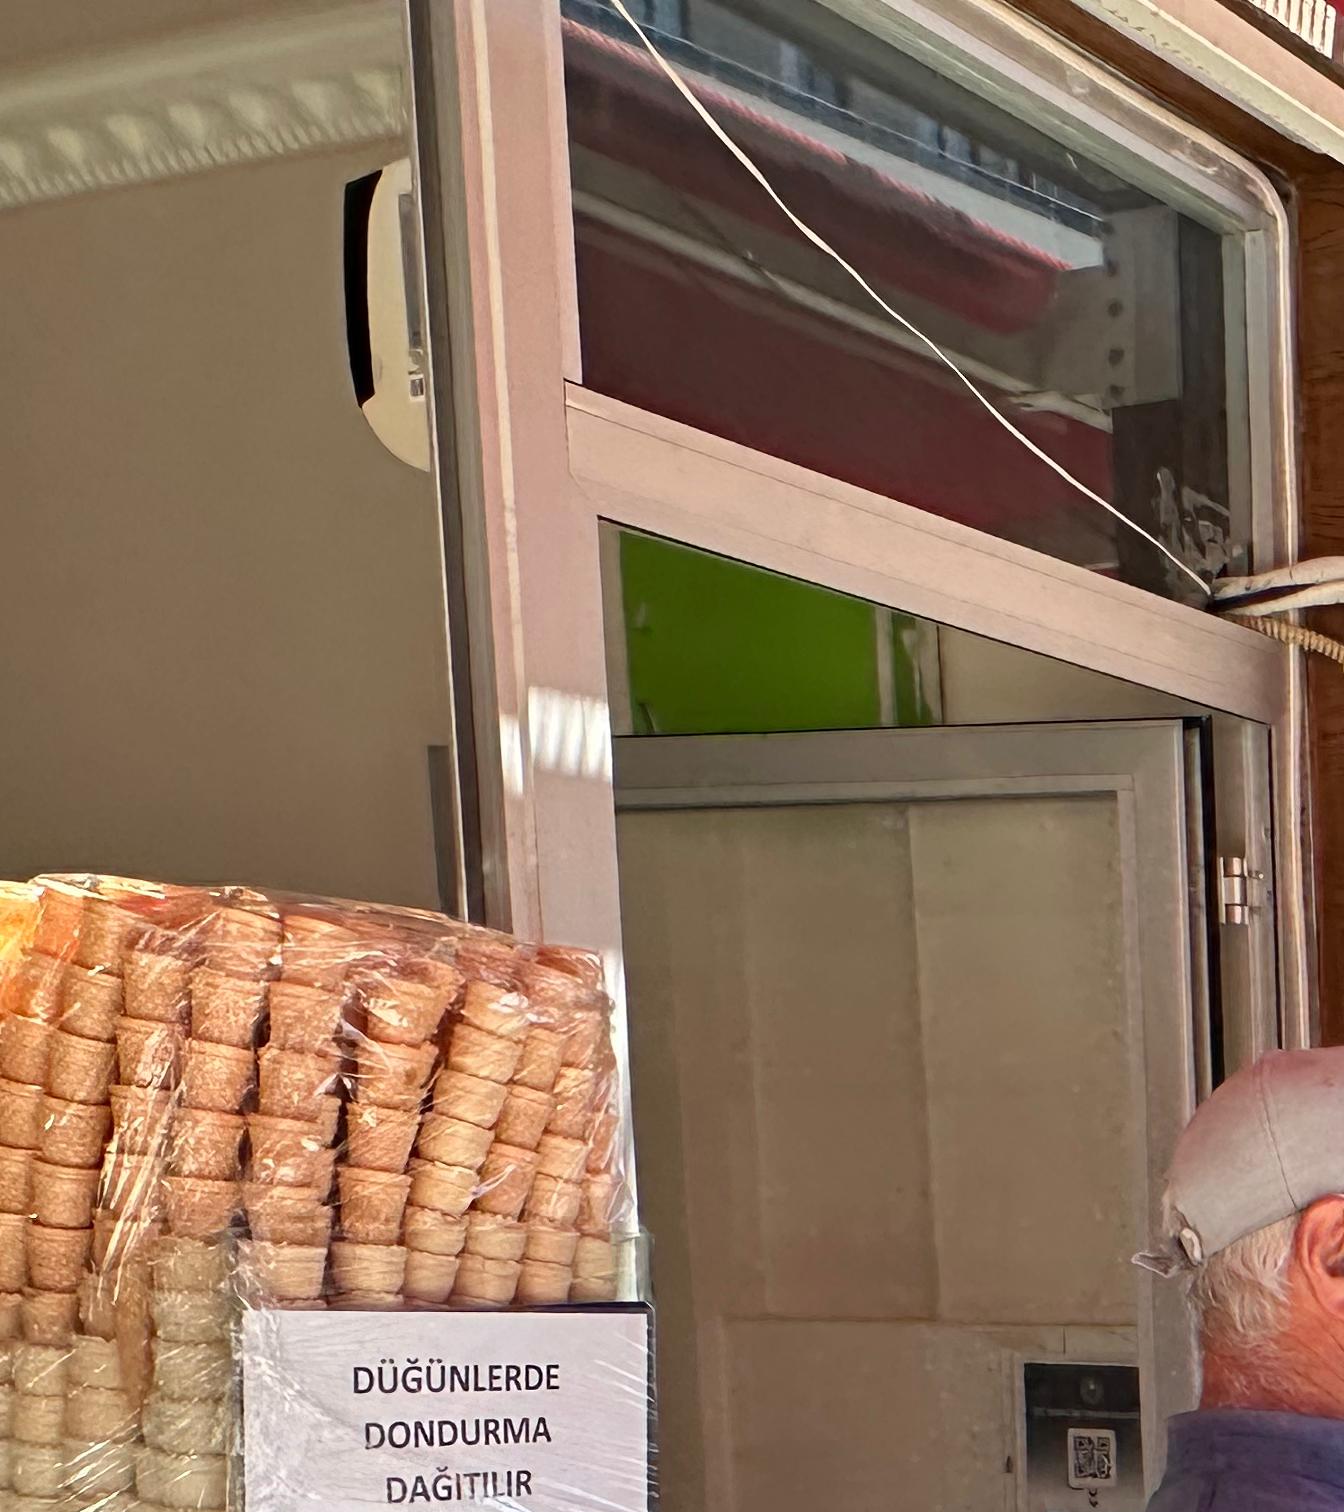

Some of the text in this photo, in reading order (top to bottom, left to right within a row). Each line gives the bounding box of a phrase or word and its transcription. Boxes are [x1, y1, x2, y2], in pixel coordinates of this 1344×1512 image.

[352, 1357, 561, 1396] DÜĞÜNLERDE
[364, 1417, 552, 1450] DONDURMA
[385, 1466, 533, 1504] DAĞITILIR
